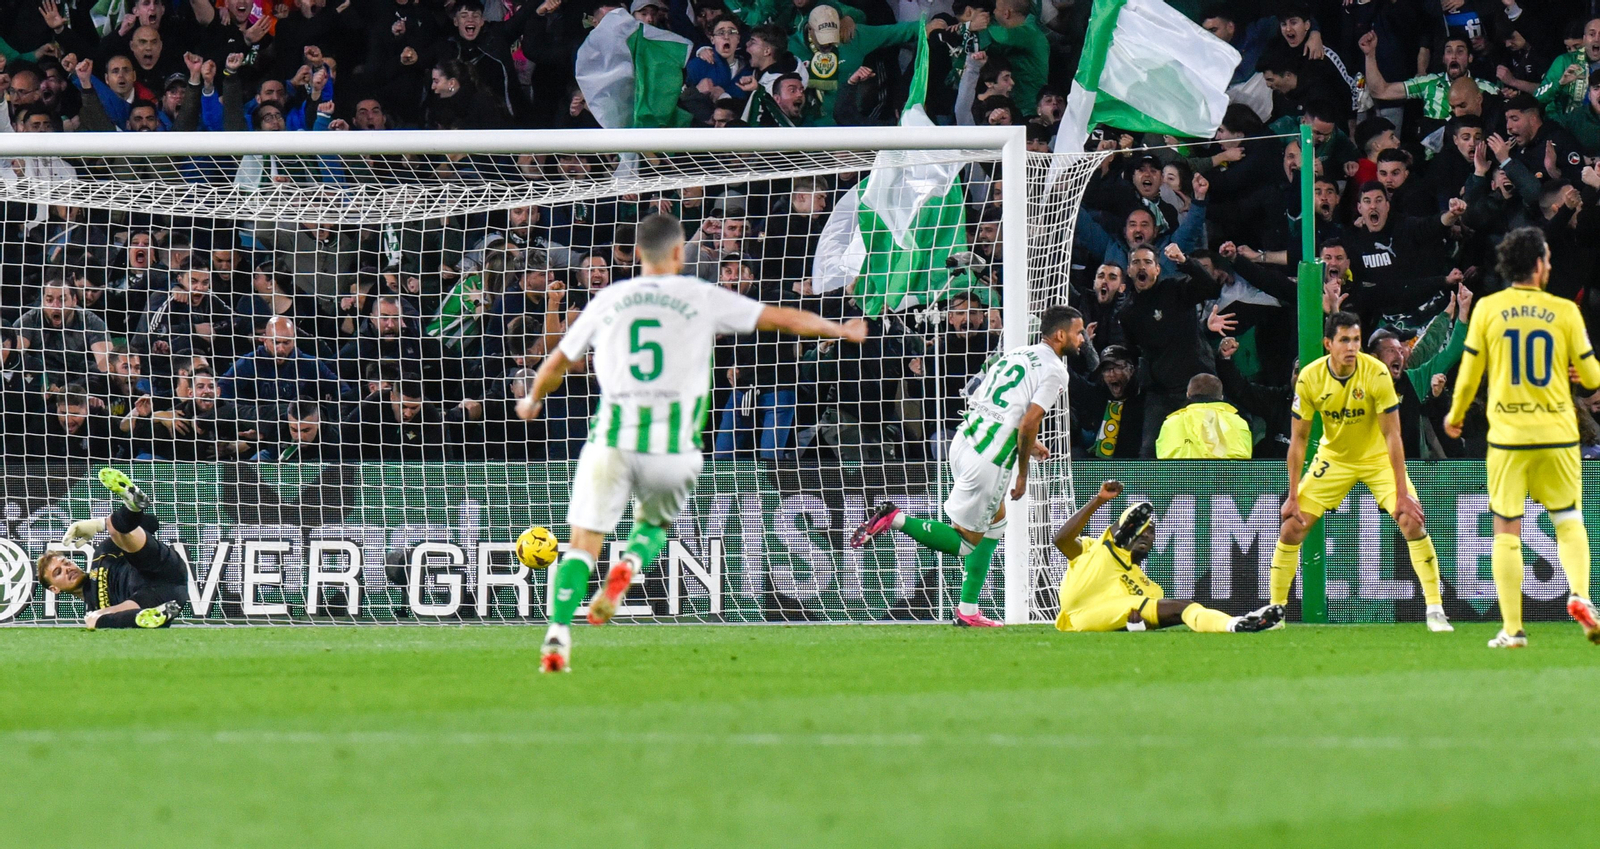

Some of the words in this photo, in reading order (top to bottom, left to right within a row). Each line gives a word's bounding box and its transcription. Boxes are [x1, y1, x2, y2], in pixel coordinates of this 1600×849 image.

[1501, 306, 1555, 323] PAREJO
[630, 318, 664, 382] 5
[1503, 329, 1554, 387] 10
[982, 360, 1025, 408] 12
[1494, 402, 1566, 413] ASCALE
[668, 494, 938, 600] VISIT
[409, 540, 721, 616] GREN
